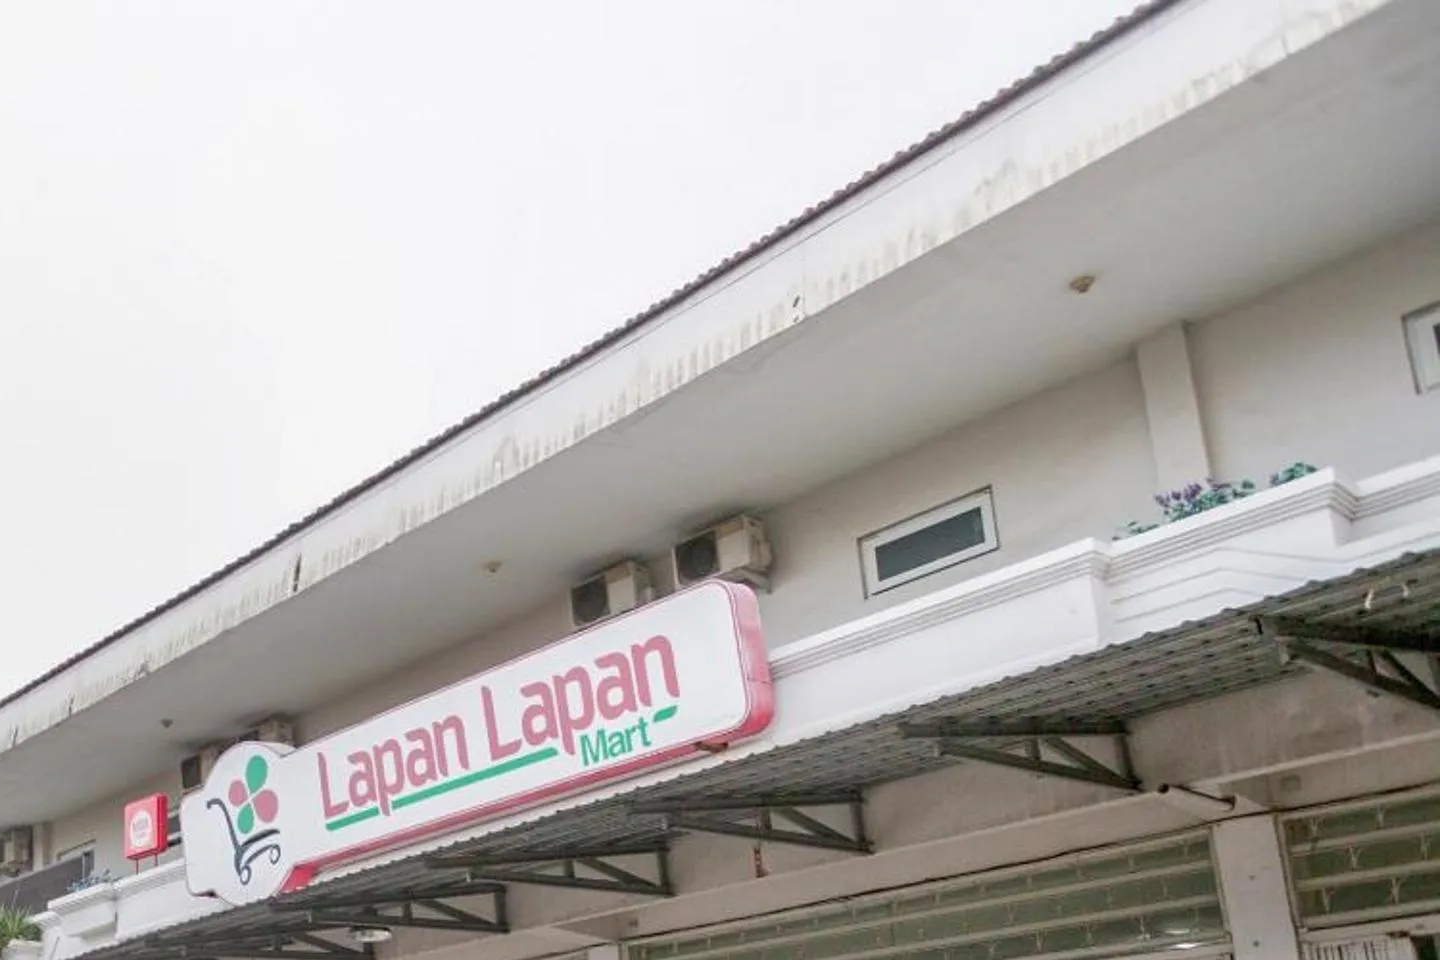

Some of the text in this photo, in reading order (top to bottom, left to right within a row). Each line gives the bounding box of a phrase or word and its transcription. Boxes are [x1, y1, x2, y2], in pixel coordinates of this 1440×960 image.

[317, 634, 681, 816] Lapan Lapan
[579, 717, 652, 766] Mart
